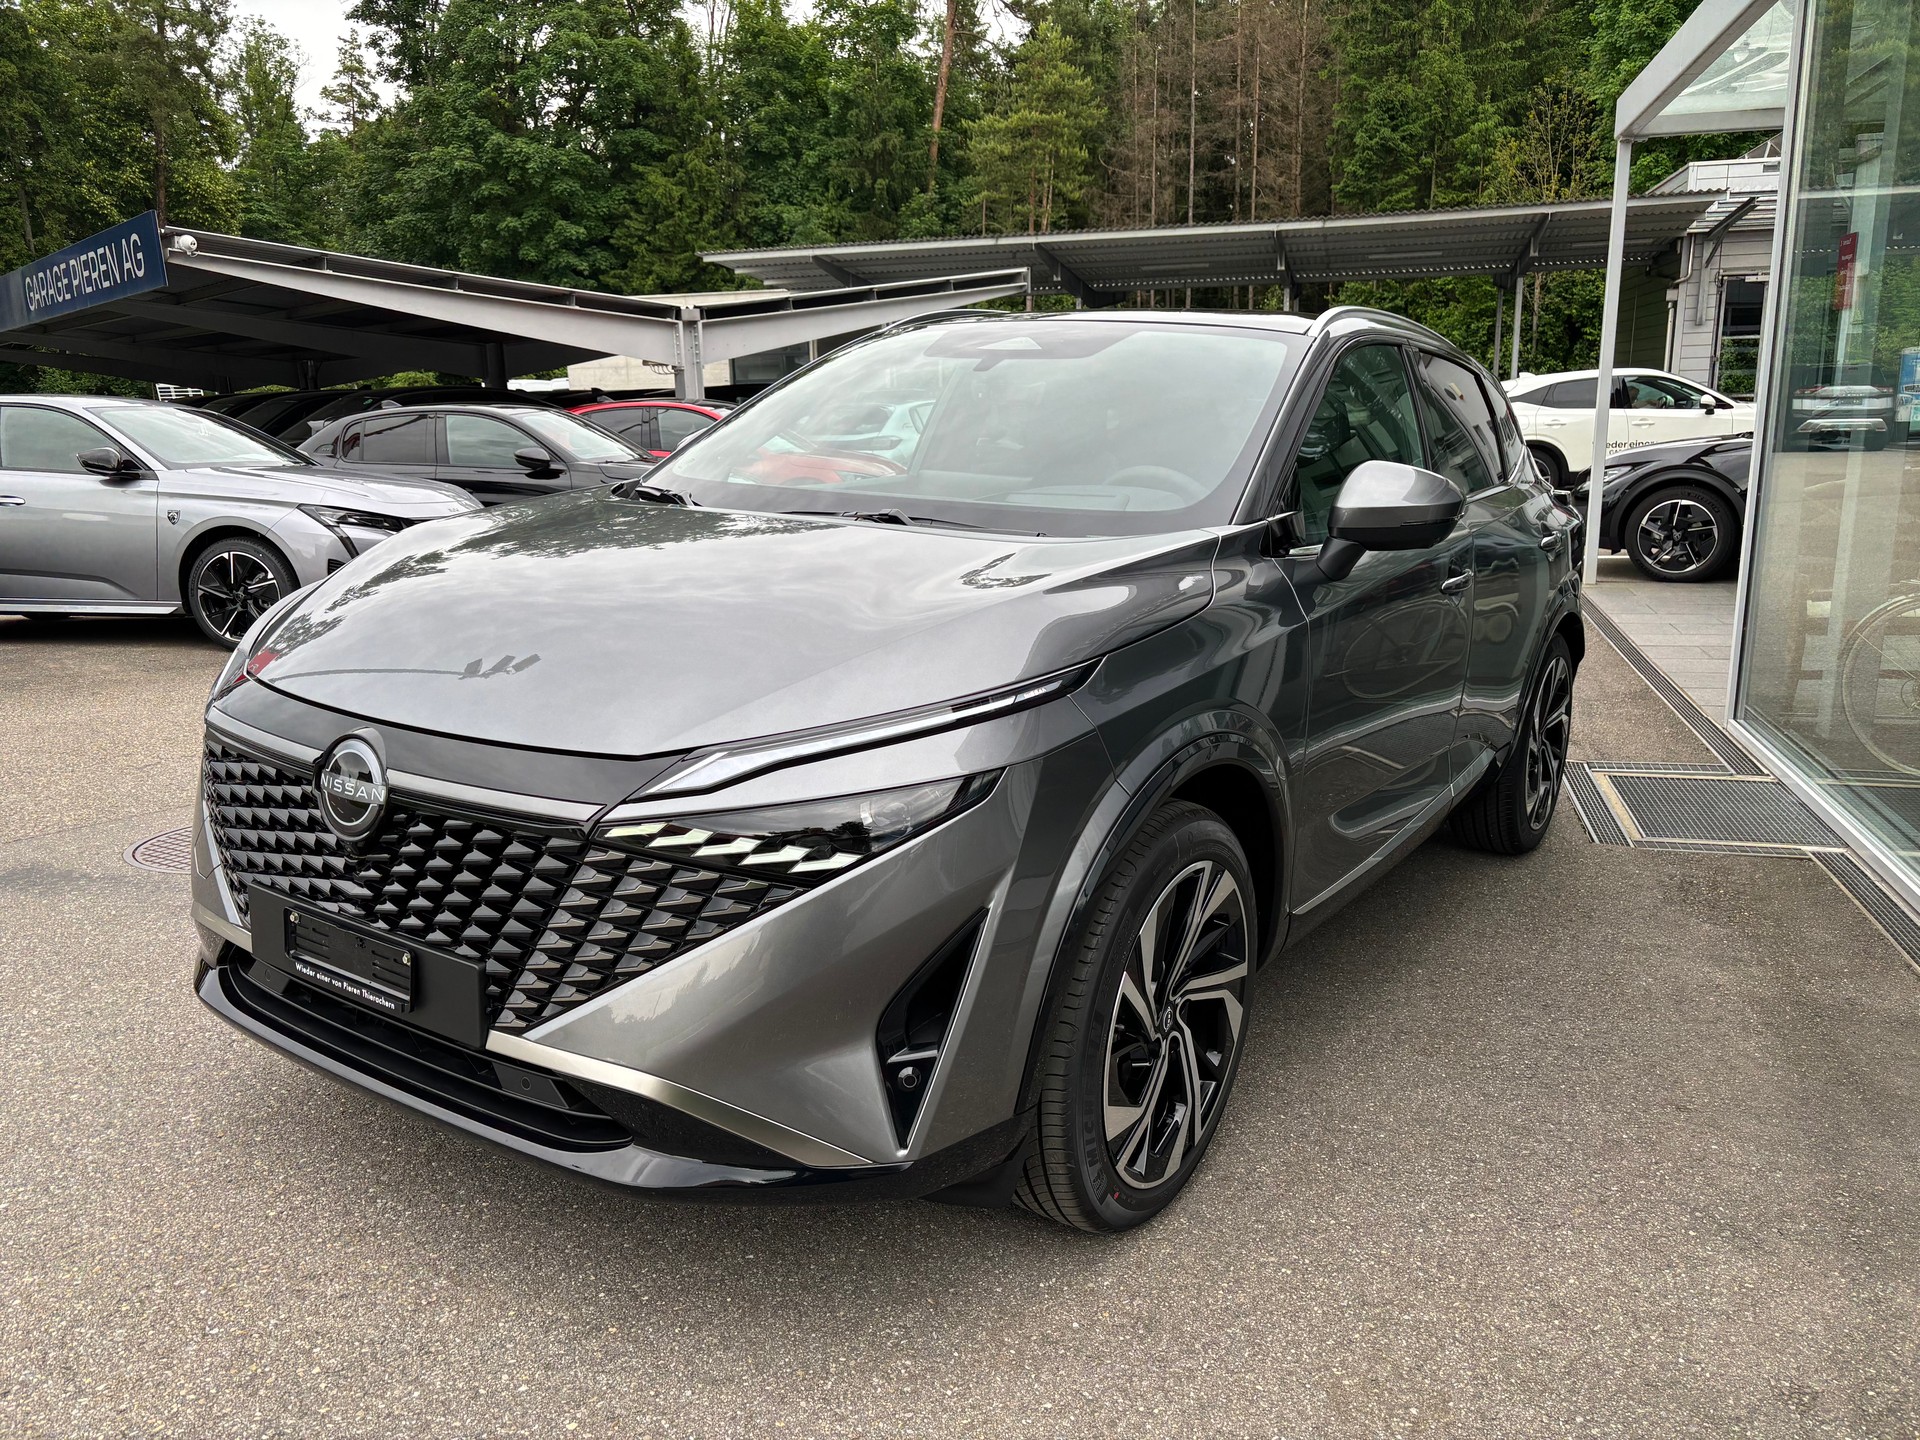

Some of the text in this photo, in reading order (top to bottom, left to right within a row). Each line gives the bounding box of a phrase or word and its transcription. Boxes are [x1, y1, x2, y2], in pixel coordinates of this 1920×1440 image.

[25, 232, 145, 311] GARAGE PIEREN AG
[321, 773, 385, 802] NISSAN
[295, 962, 315, 977] Wieder
[317, 972, 331, 983] einer
[332, 979, 342, 988] von
[343, 981, 361, 996] Pieren
